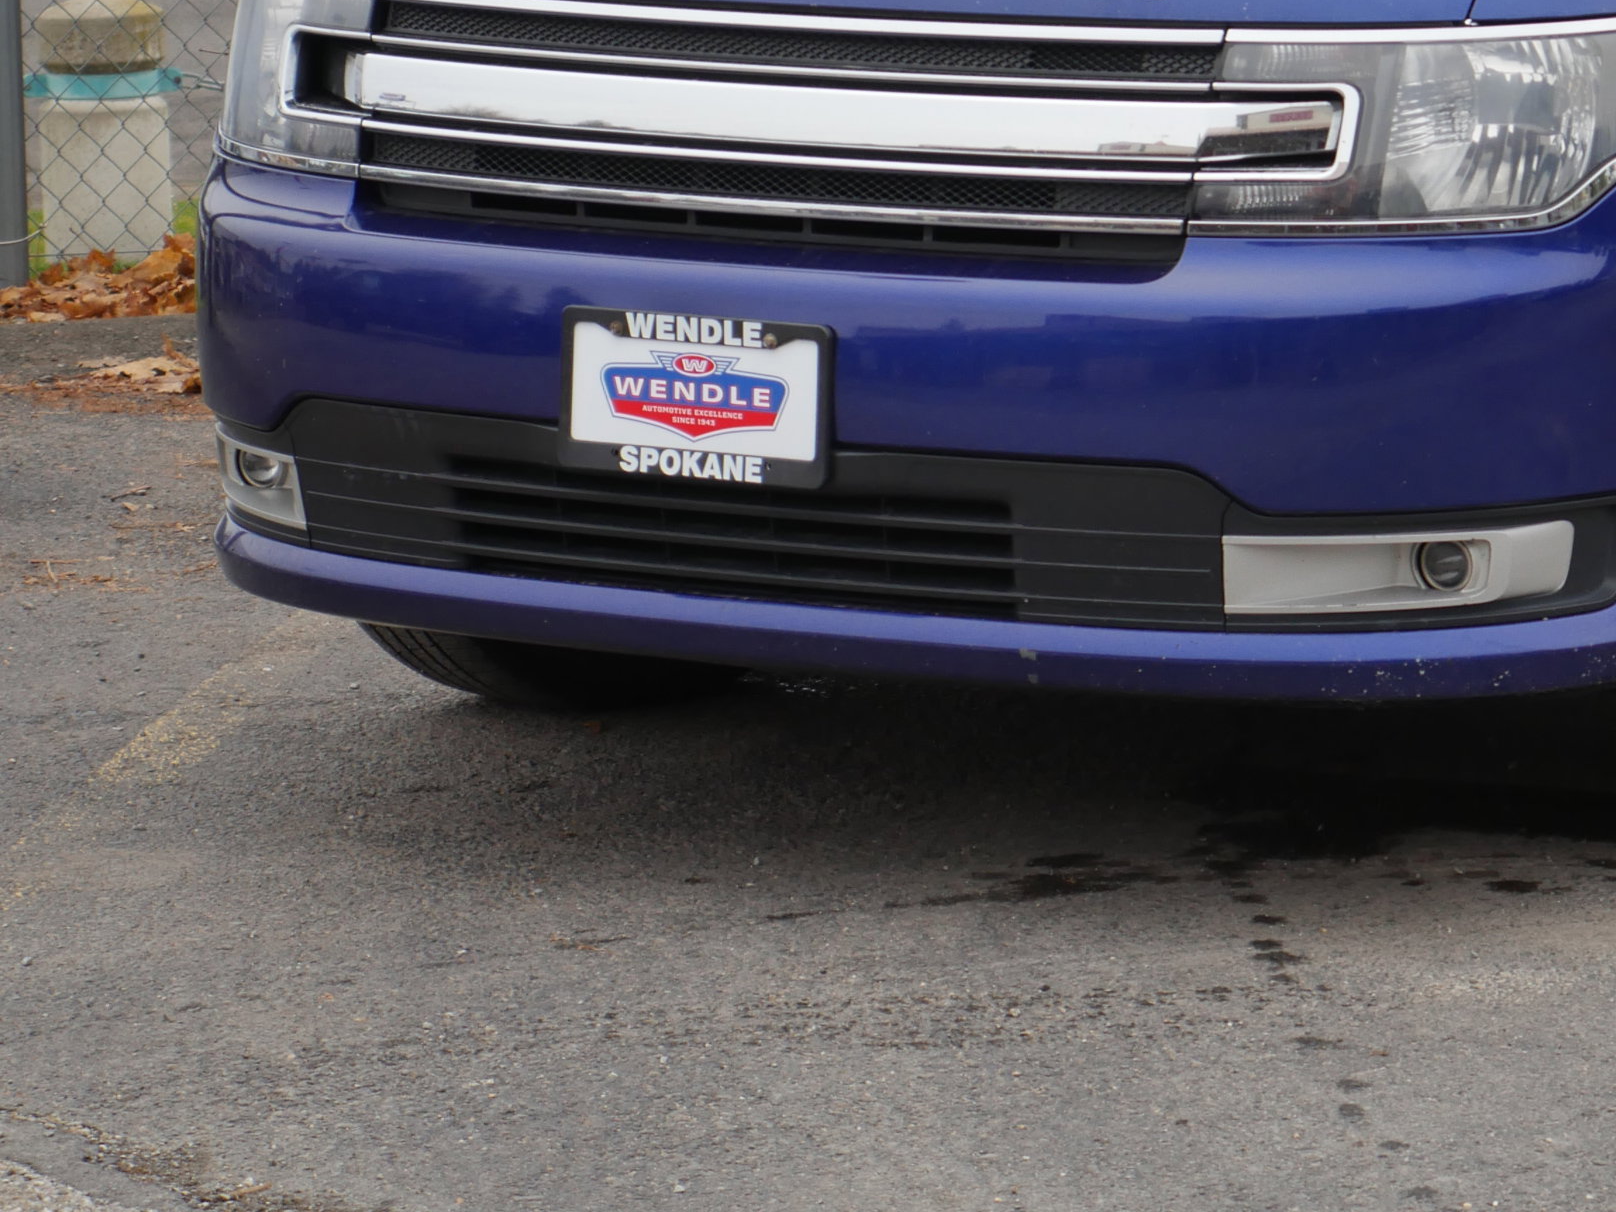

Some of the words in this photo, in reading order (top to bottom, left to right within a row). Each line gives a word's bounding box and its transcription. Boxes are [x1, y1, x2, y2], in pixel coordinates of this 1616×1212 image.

[625, 312, 762, 348] WENDLE
[614, 376, 771, 407] WENDLE
[642, 405, 692, 416] AUTOMOTIVE
[694, 409, 743, 420] EXCELLENCE
[672, 416, 695, 425] SINCE
[697, 419, 716, 427] 1943
[619, 445, 762, 483] SPOKANE
